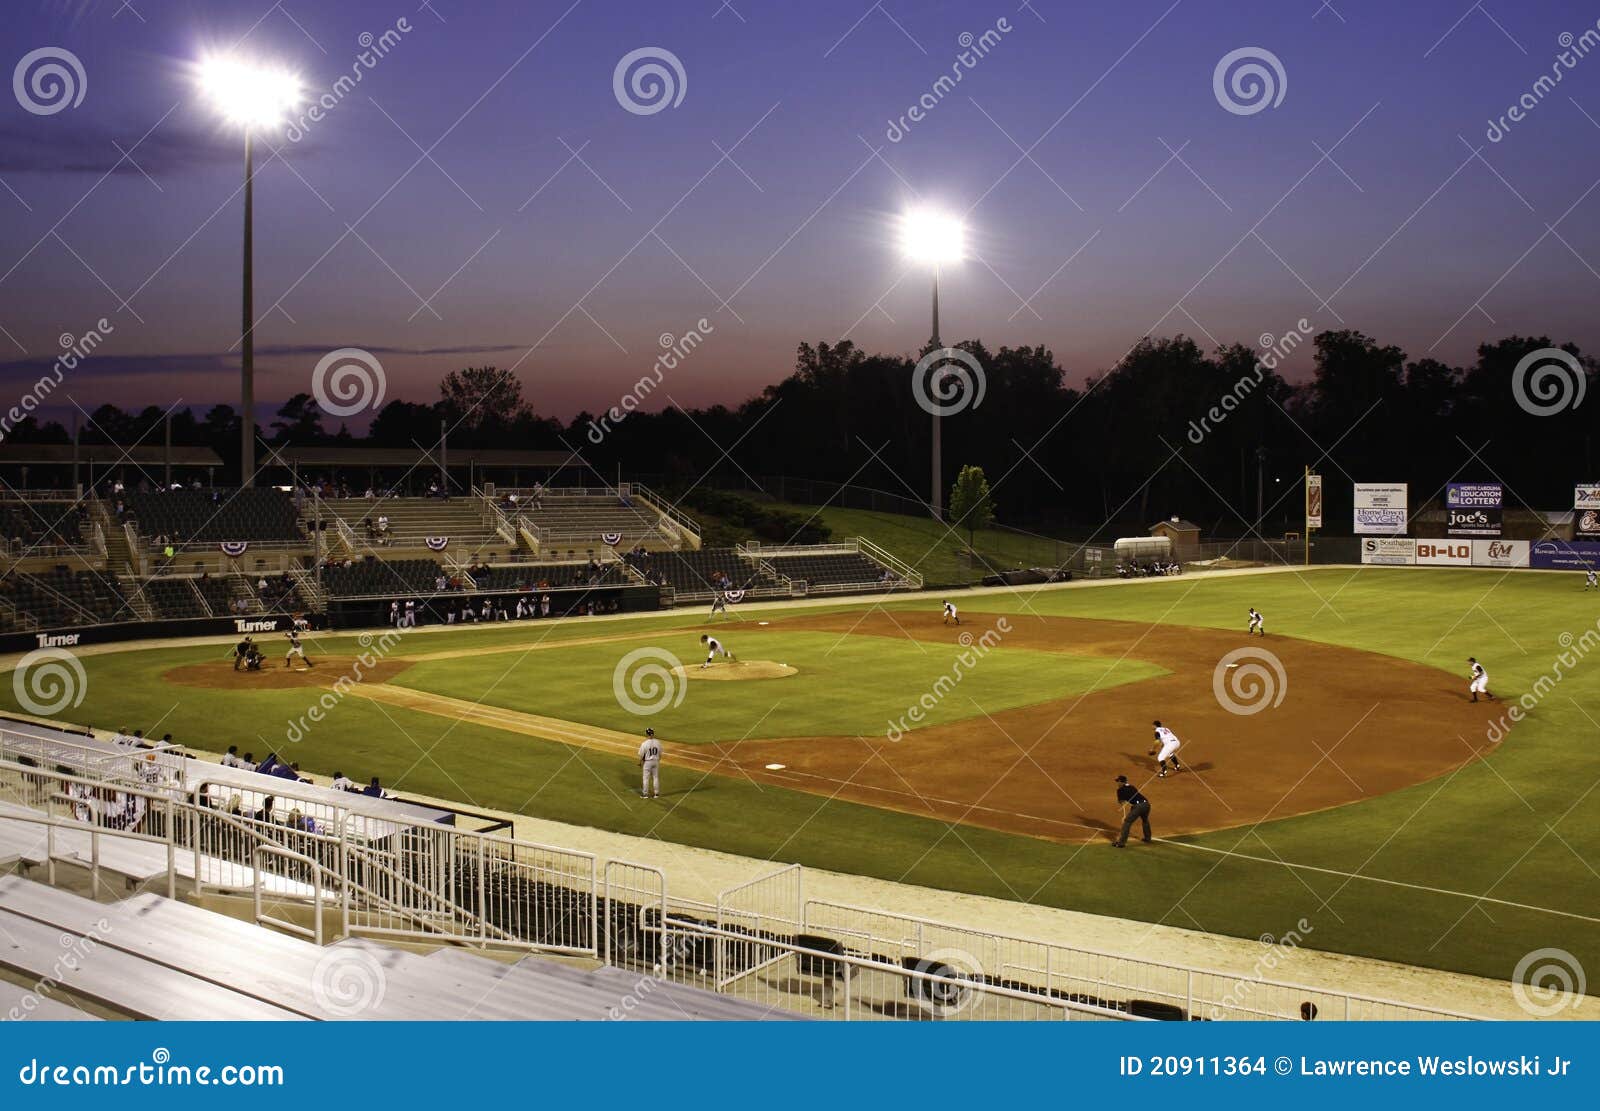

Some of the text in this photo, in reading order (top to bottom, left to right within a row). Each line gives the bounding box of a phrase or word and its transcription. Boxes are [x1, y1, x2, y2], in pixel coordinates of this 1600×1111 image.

[1460, 497, 1501, 505] LOTTERY
[1357, 515, 1405, 523] OXYGEN
[1448, 510, 1488, 526] joe's
[1417, 545, 1470, 558] BI-LO
[235, 619, 278, 633] Turner
[35, 633, 80, 648] Turner
[648, 746, 658, 757] 10
